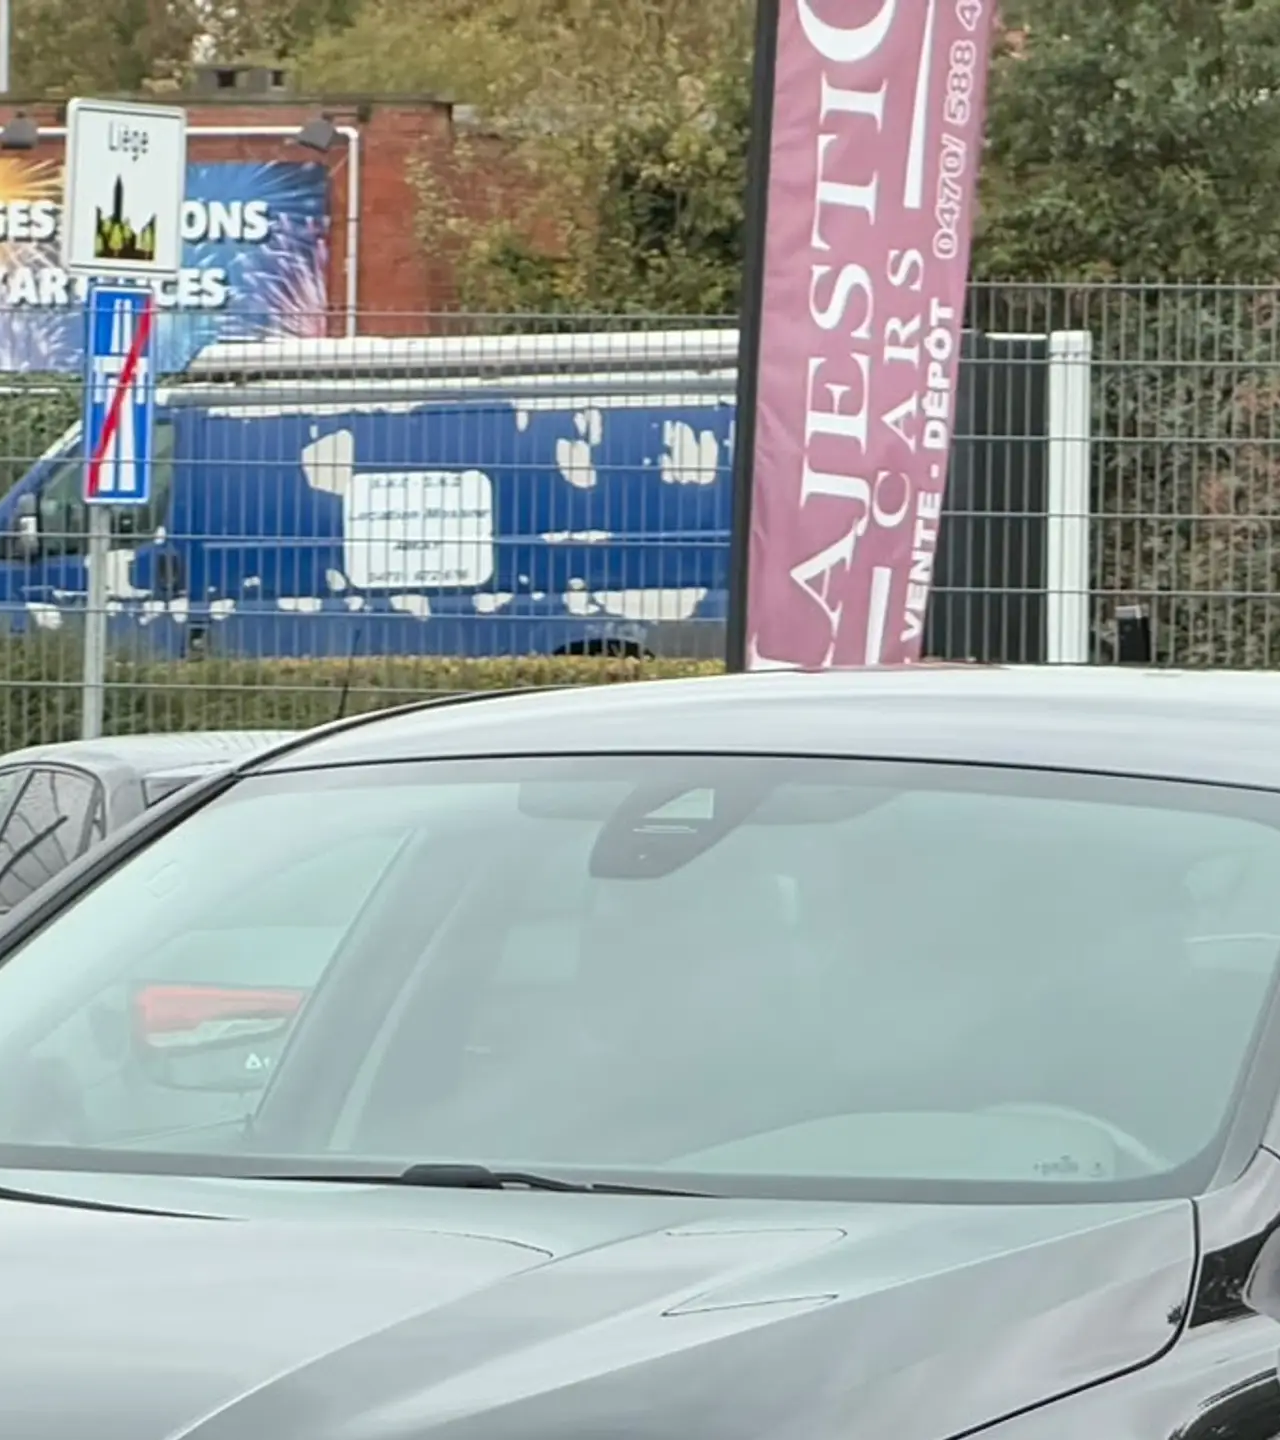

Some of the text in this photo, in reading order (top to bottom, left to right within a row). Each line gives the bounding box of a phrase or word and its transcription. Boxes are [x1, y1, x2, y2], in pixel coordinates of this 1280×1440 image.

[108, 121, 150, 162] Liège
[747, 0, 897, 672] AJESTIC
[873, 248, 925, 527] CARS
[901, 490, 942, 642] VENTE
